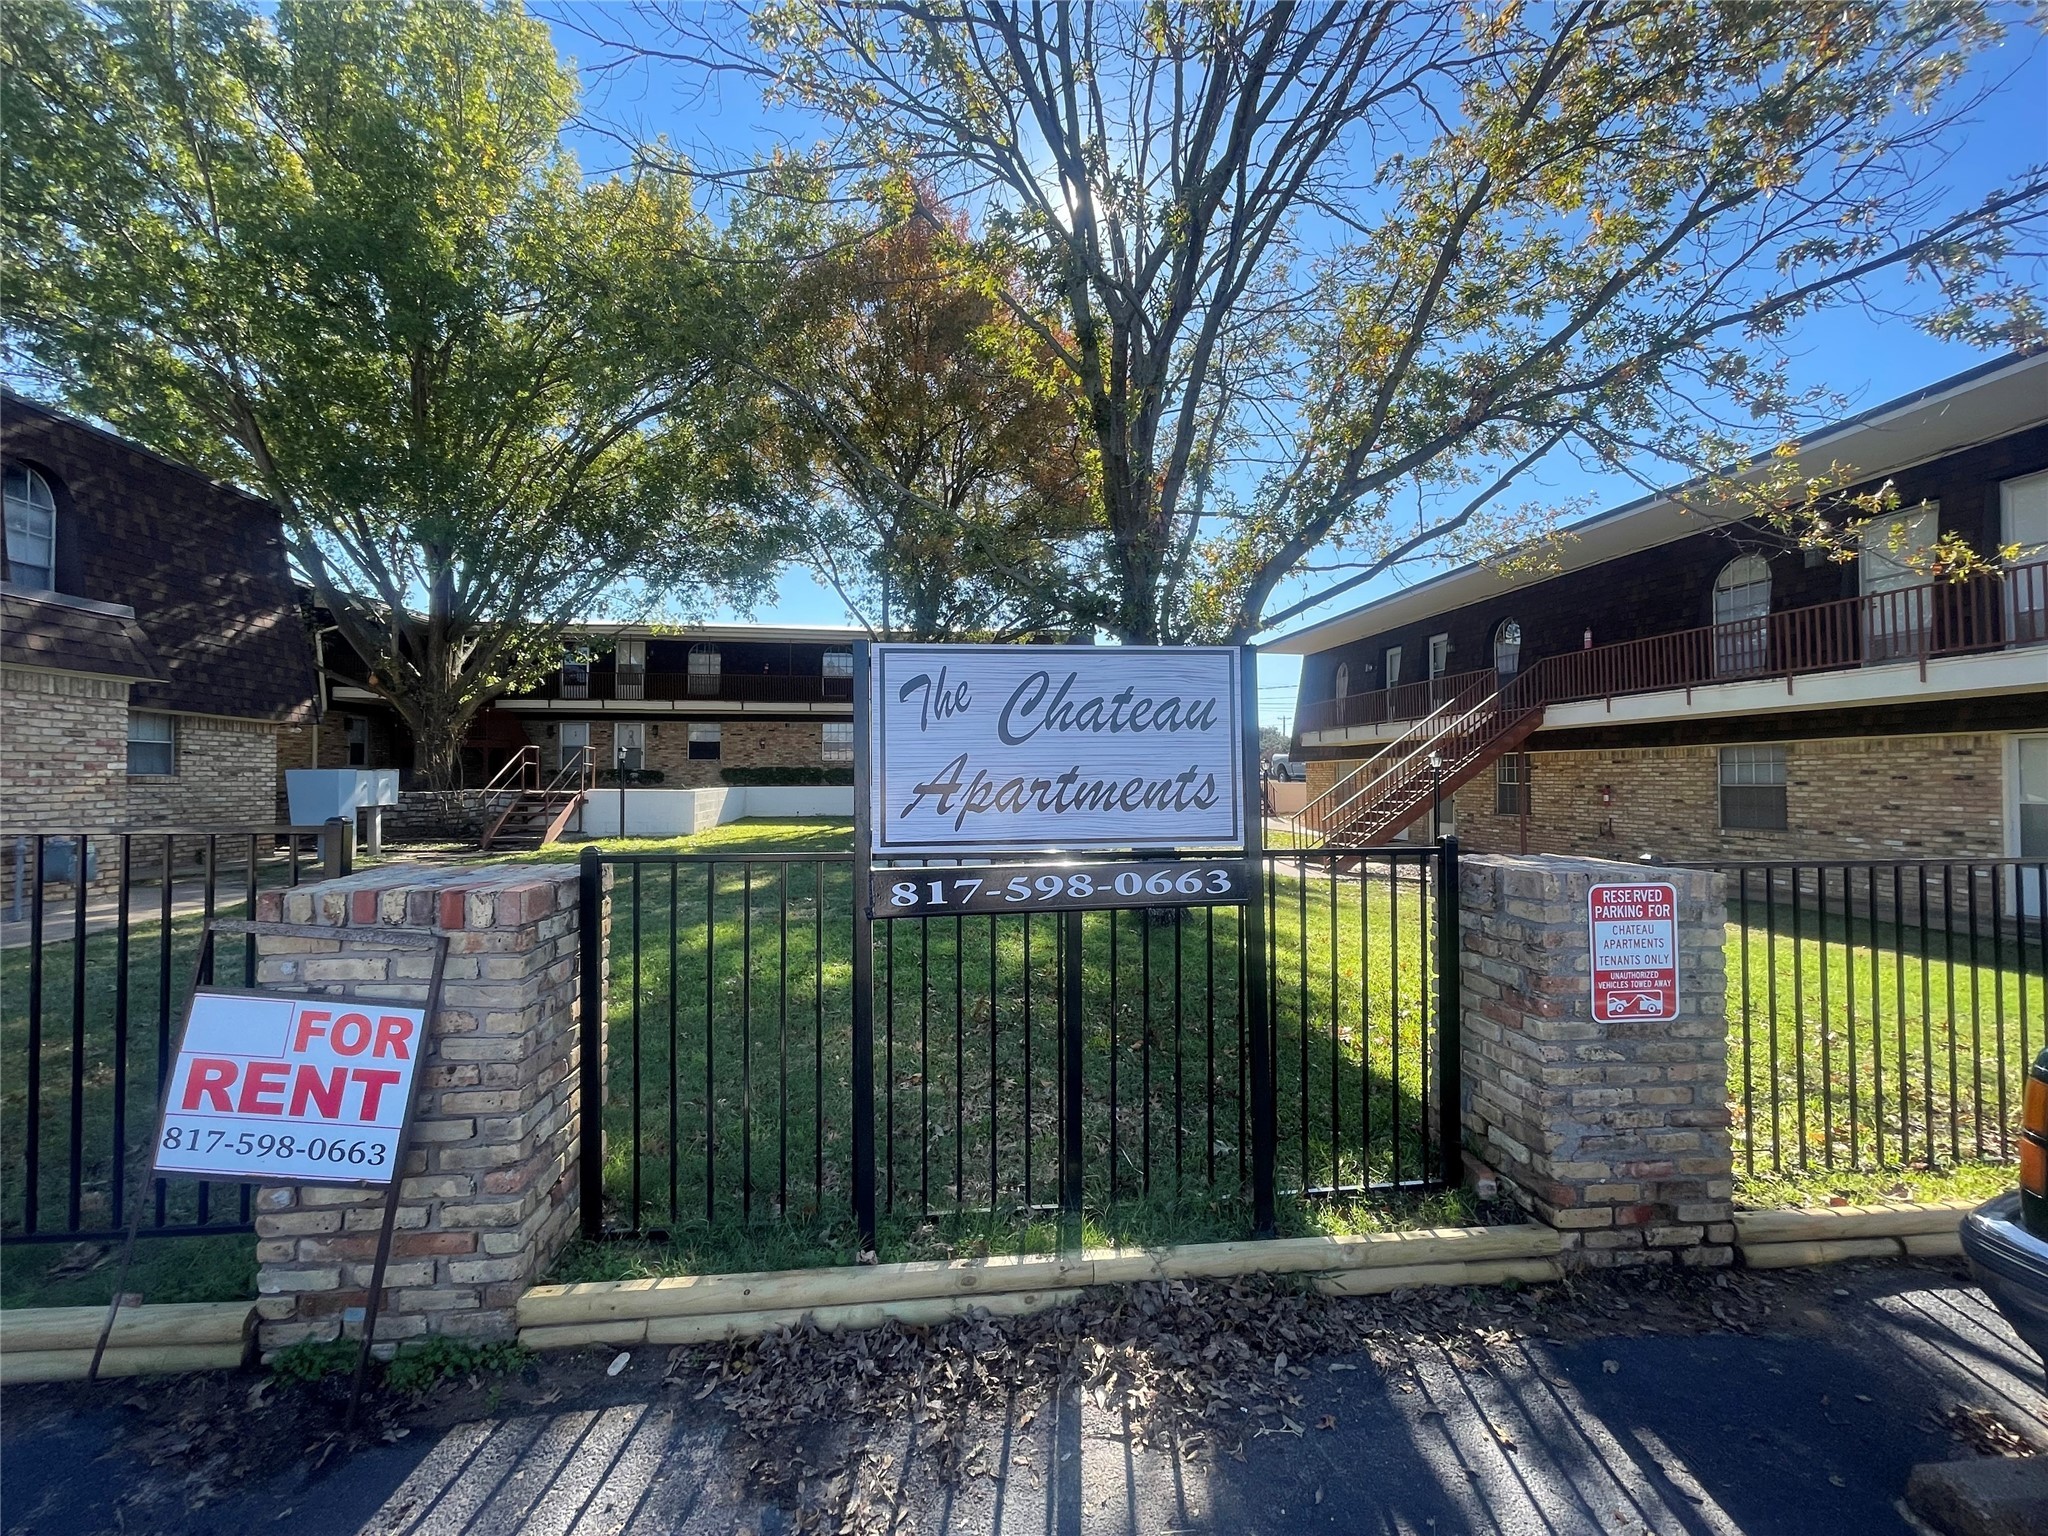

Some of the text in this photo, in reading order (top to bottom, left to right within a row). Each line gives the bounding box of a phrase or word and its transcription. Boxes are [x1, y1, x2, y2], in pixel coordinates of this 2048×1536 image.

[899, 665, 1218, 746] The Chateau
[900, 752, 1220, 832] Apartments
[890, 869, 1233, 907] 817-598-0663
[1602, 889, 1662, 903] RESERVED
[1595, 904, 1671, 919] PARKING FOR
[1612, 924, 1655, 935] CHATEAU
[1603, 938, 1664, 950] APARTMENTS
[1599, 954, 1670, 966] TENANTS ONLY
[1610, 970, 1659, 980] UNAUTHORIZED
[1598, 979, 1672, 990] VEHICLES TOWED AWAY
[293, 1010, 414, 1060] FOR
[181, 1057, 401, 1122] RENT
[162, 1126, 387, 1166] 817-598-0663
